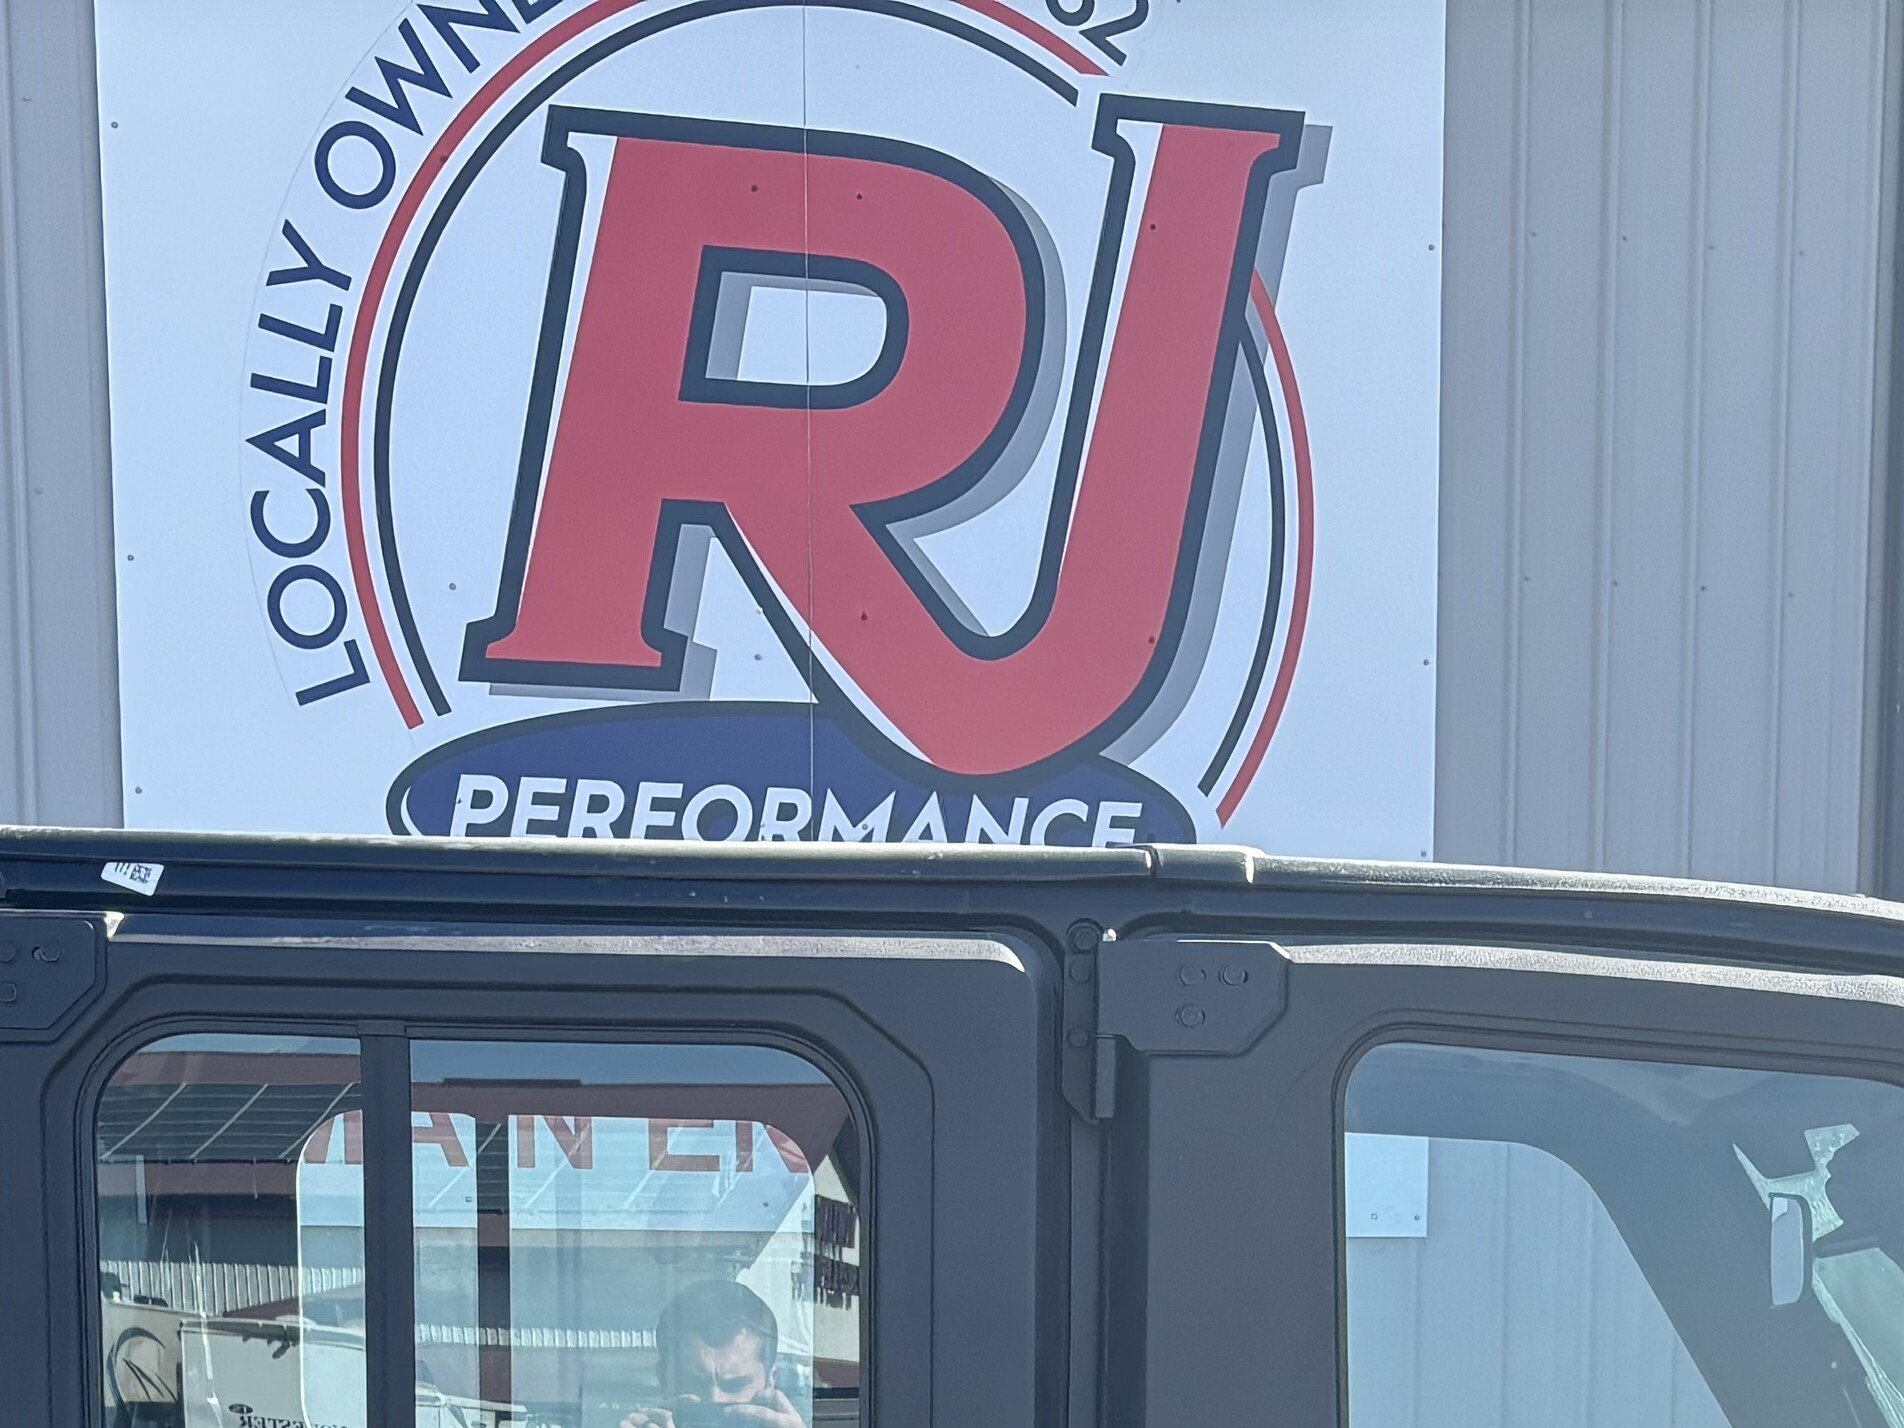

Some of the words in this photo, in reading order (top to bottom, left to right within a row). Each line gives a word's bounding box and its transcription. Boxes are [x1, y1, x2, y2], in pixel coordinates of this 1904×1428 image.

[245, 218, 371, 707] LOCALLY
[314, 0, 566, 209] OWN
[458, 93, 1307, 779] RJ
[448, 773, 1144, 847] PERFORMANCE
